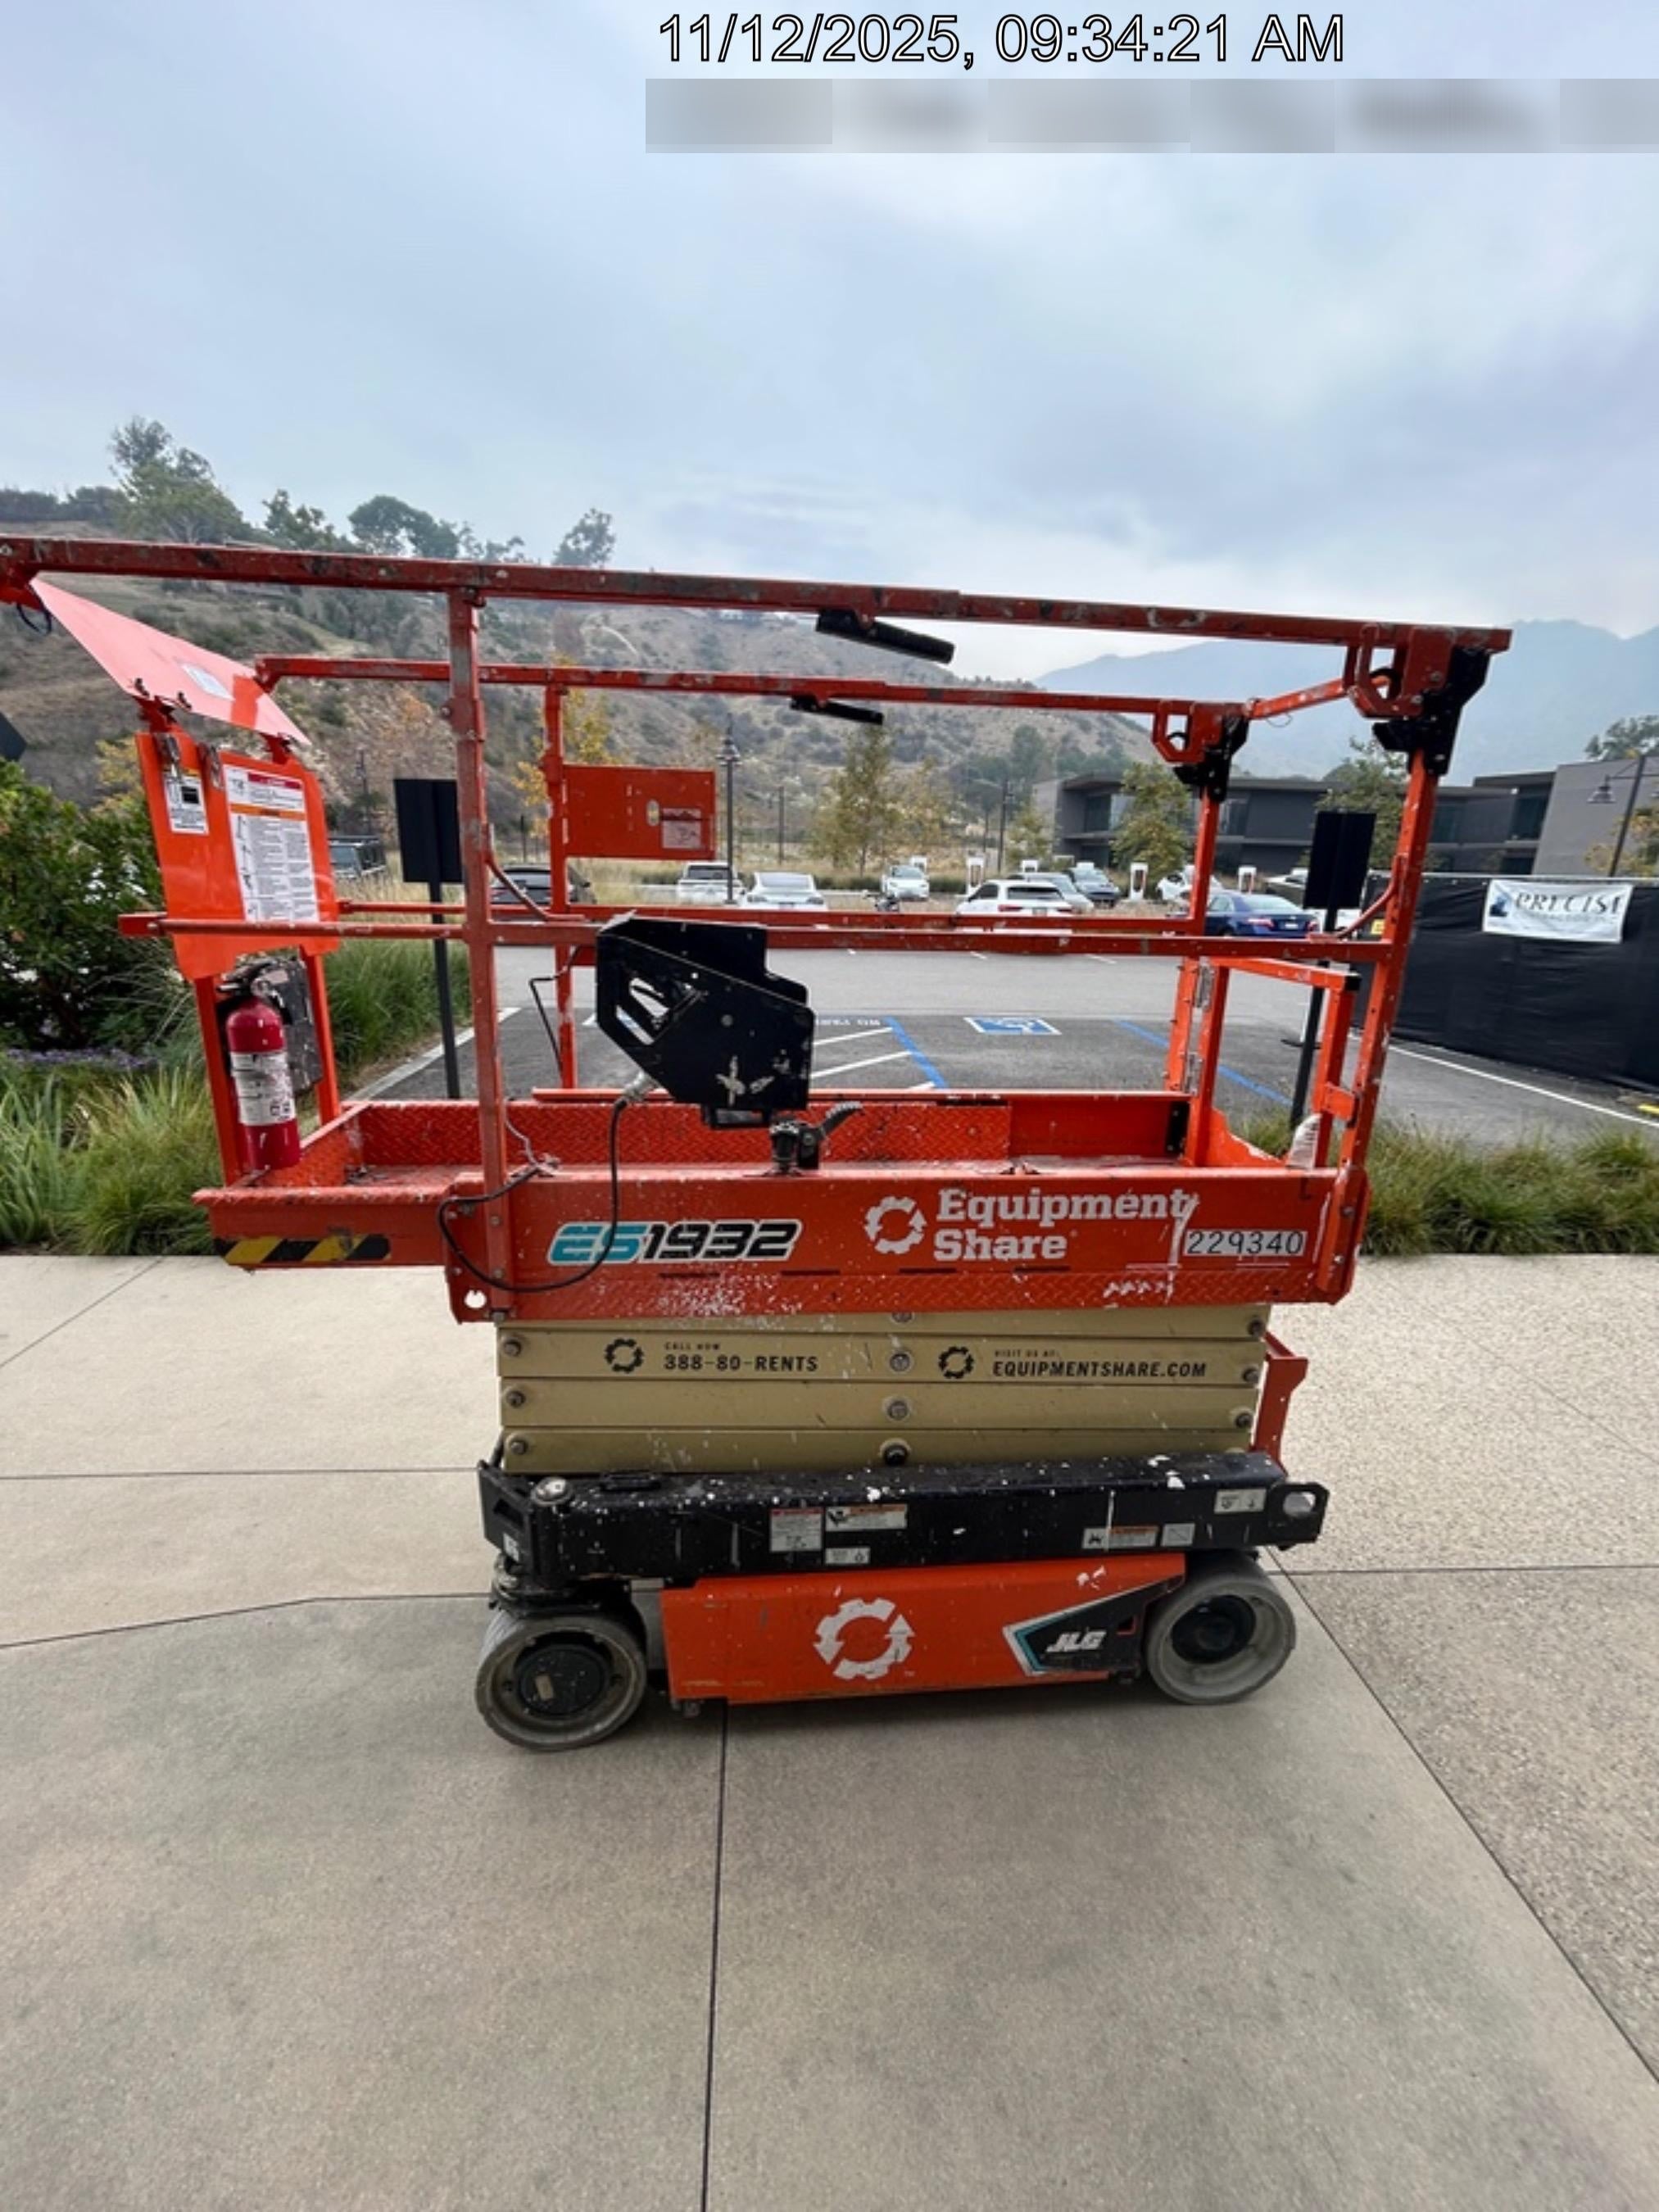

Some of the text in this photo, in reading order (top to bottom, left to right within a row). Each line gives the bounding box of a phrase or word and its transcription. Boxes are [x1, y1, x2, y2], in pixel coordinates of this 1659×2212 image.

[936, 1188, 1193, 1228] Equipment
[546, 1220, 803, 1266] ES1932
[933, 1229, 1067, 1262] Share
[1187, 1231, 1303, 1255] 229340
[992, 1361, 1207, 1377] EQUIPMENTSHARE.COM
[1046, 1630, 1106, 1653] JLG
